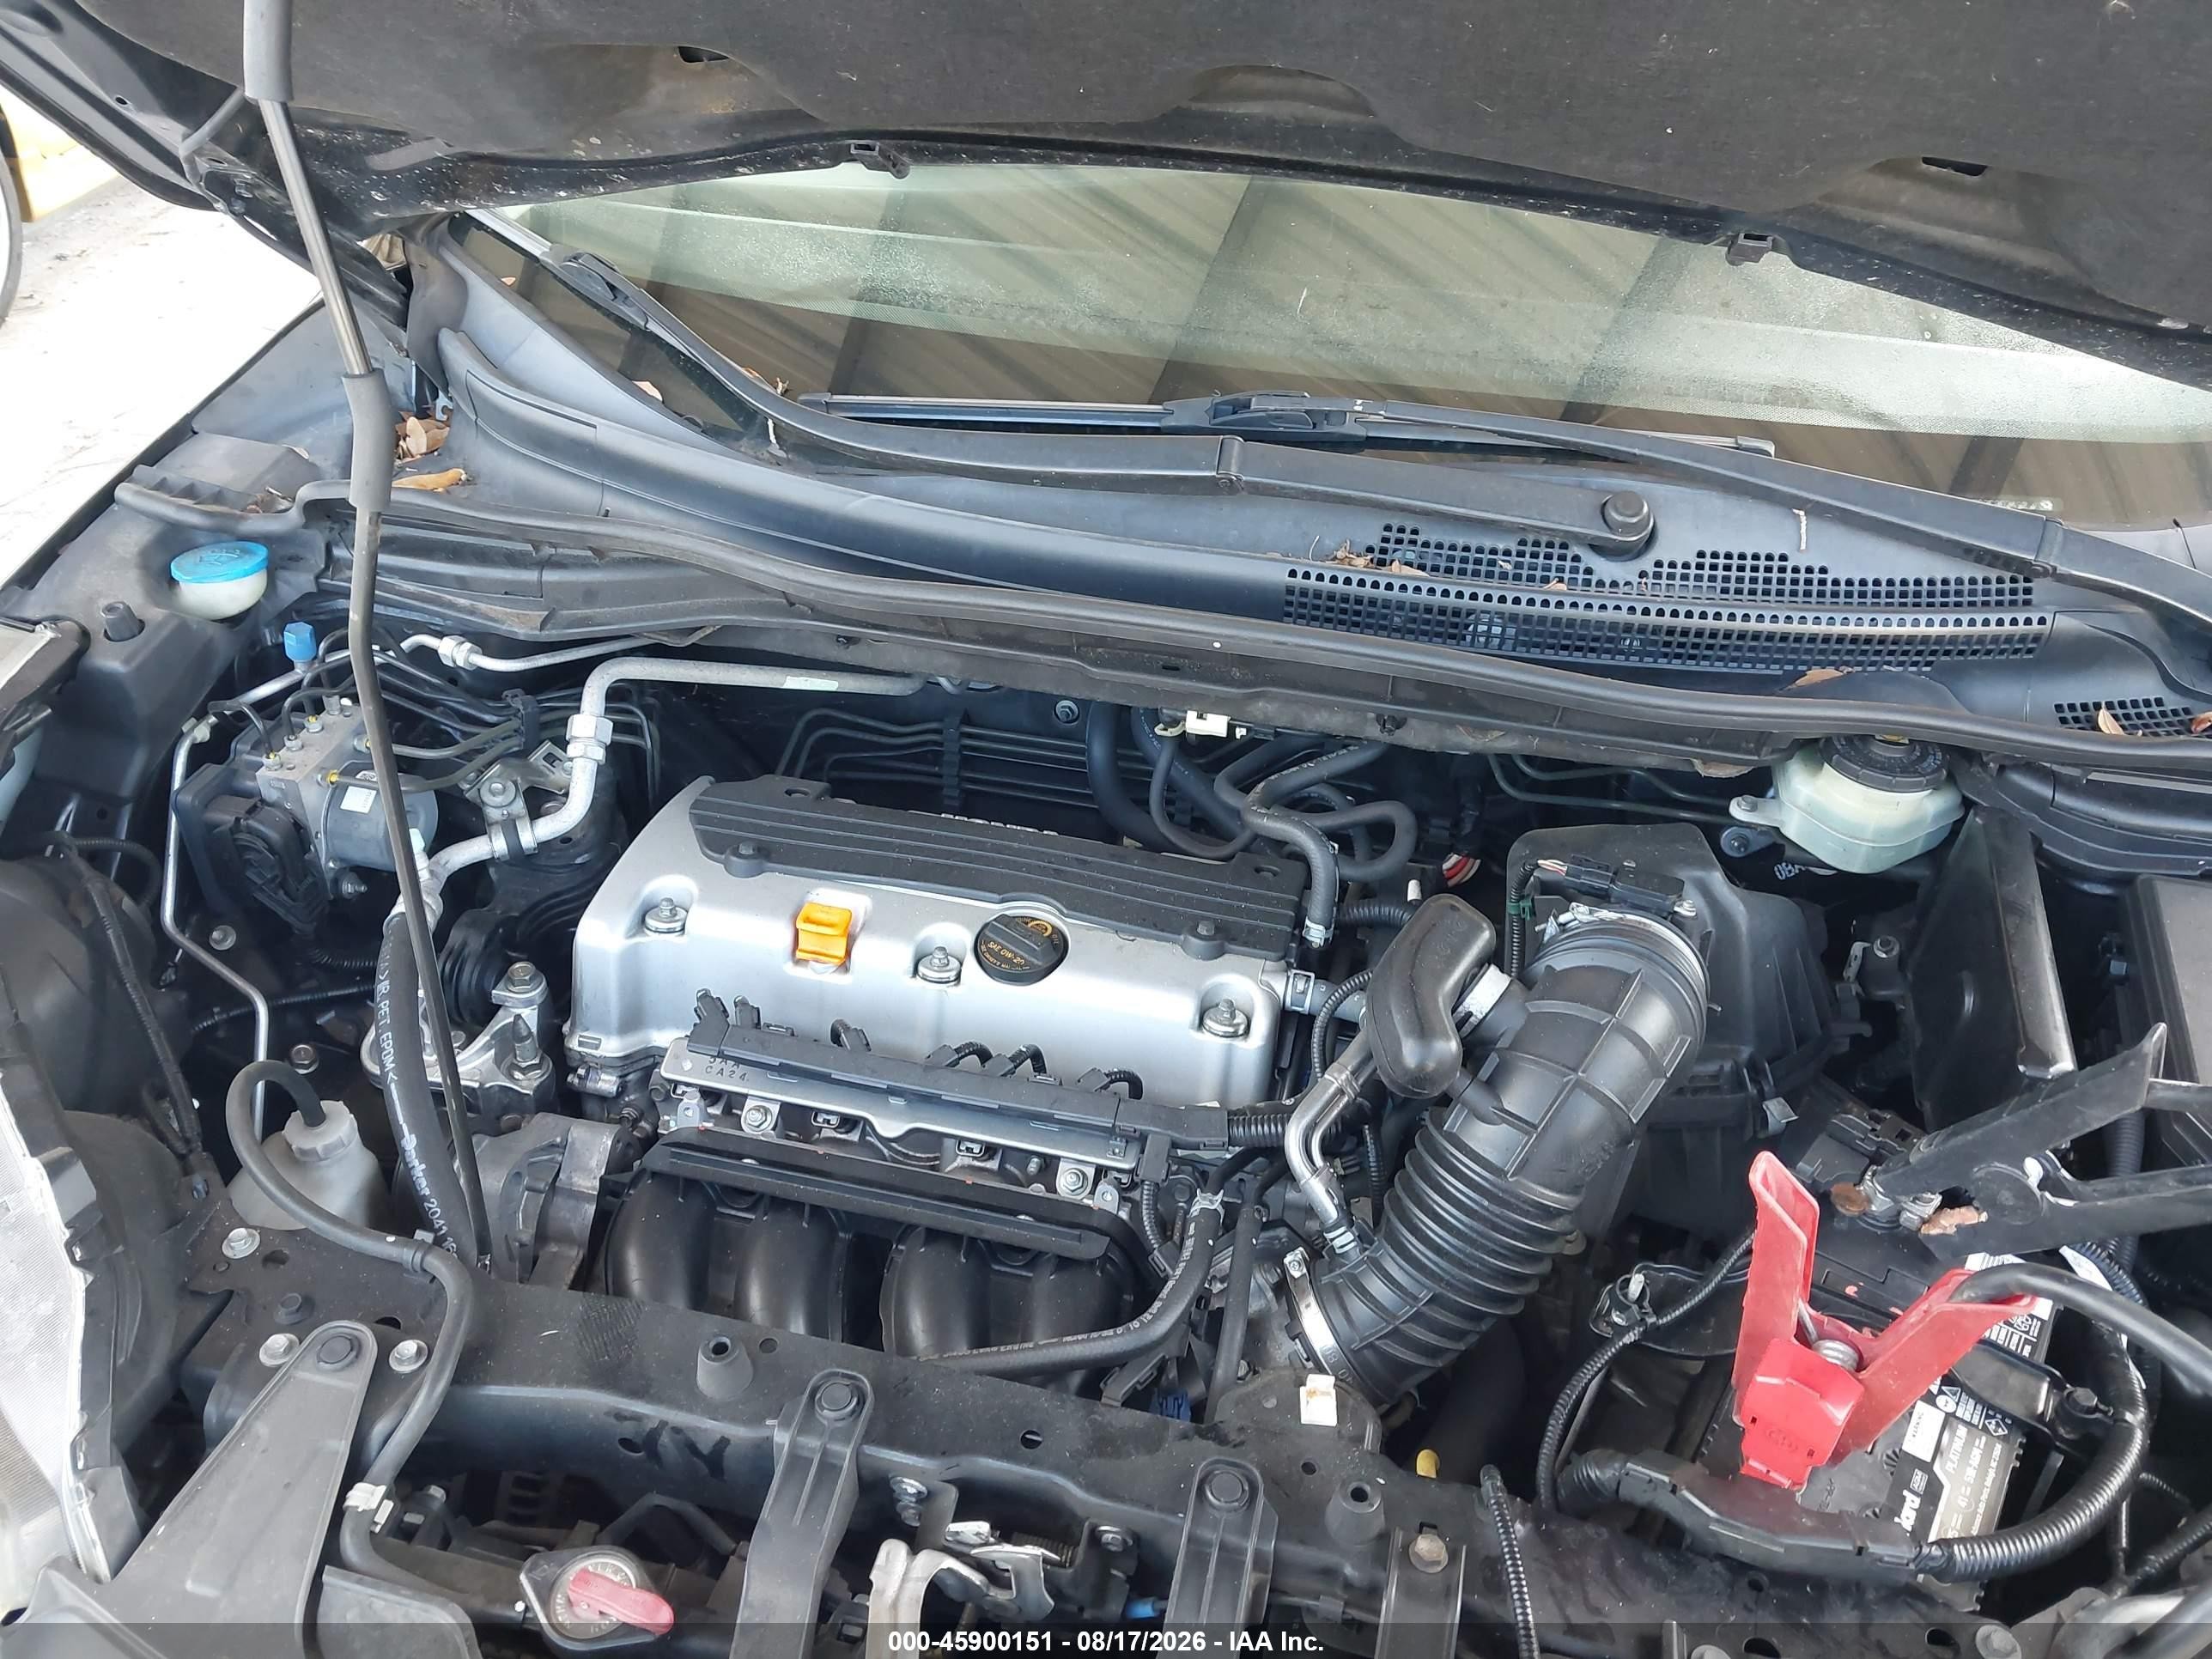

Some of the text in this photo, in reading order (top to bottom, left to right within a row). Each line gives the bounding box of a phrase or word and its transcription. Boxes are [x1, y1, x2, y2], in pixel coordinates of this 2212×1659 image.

[988, 941, 1002, 952] SAE
[400, 1133, 430, 1195] Parker
[424, 1198, 448, 1237] 2041
[1944, 1424, 1969, 1474] PLATINUM
